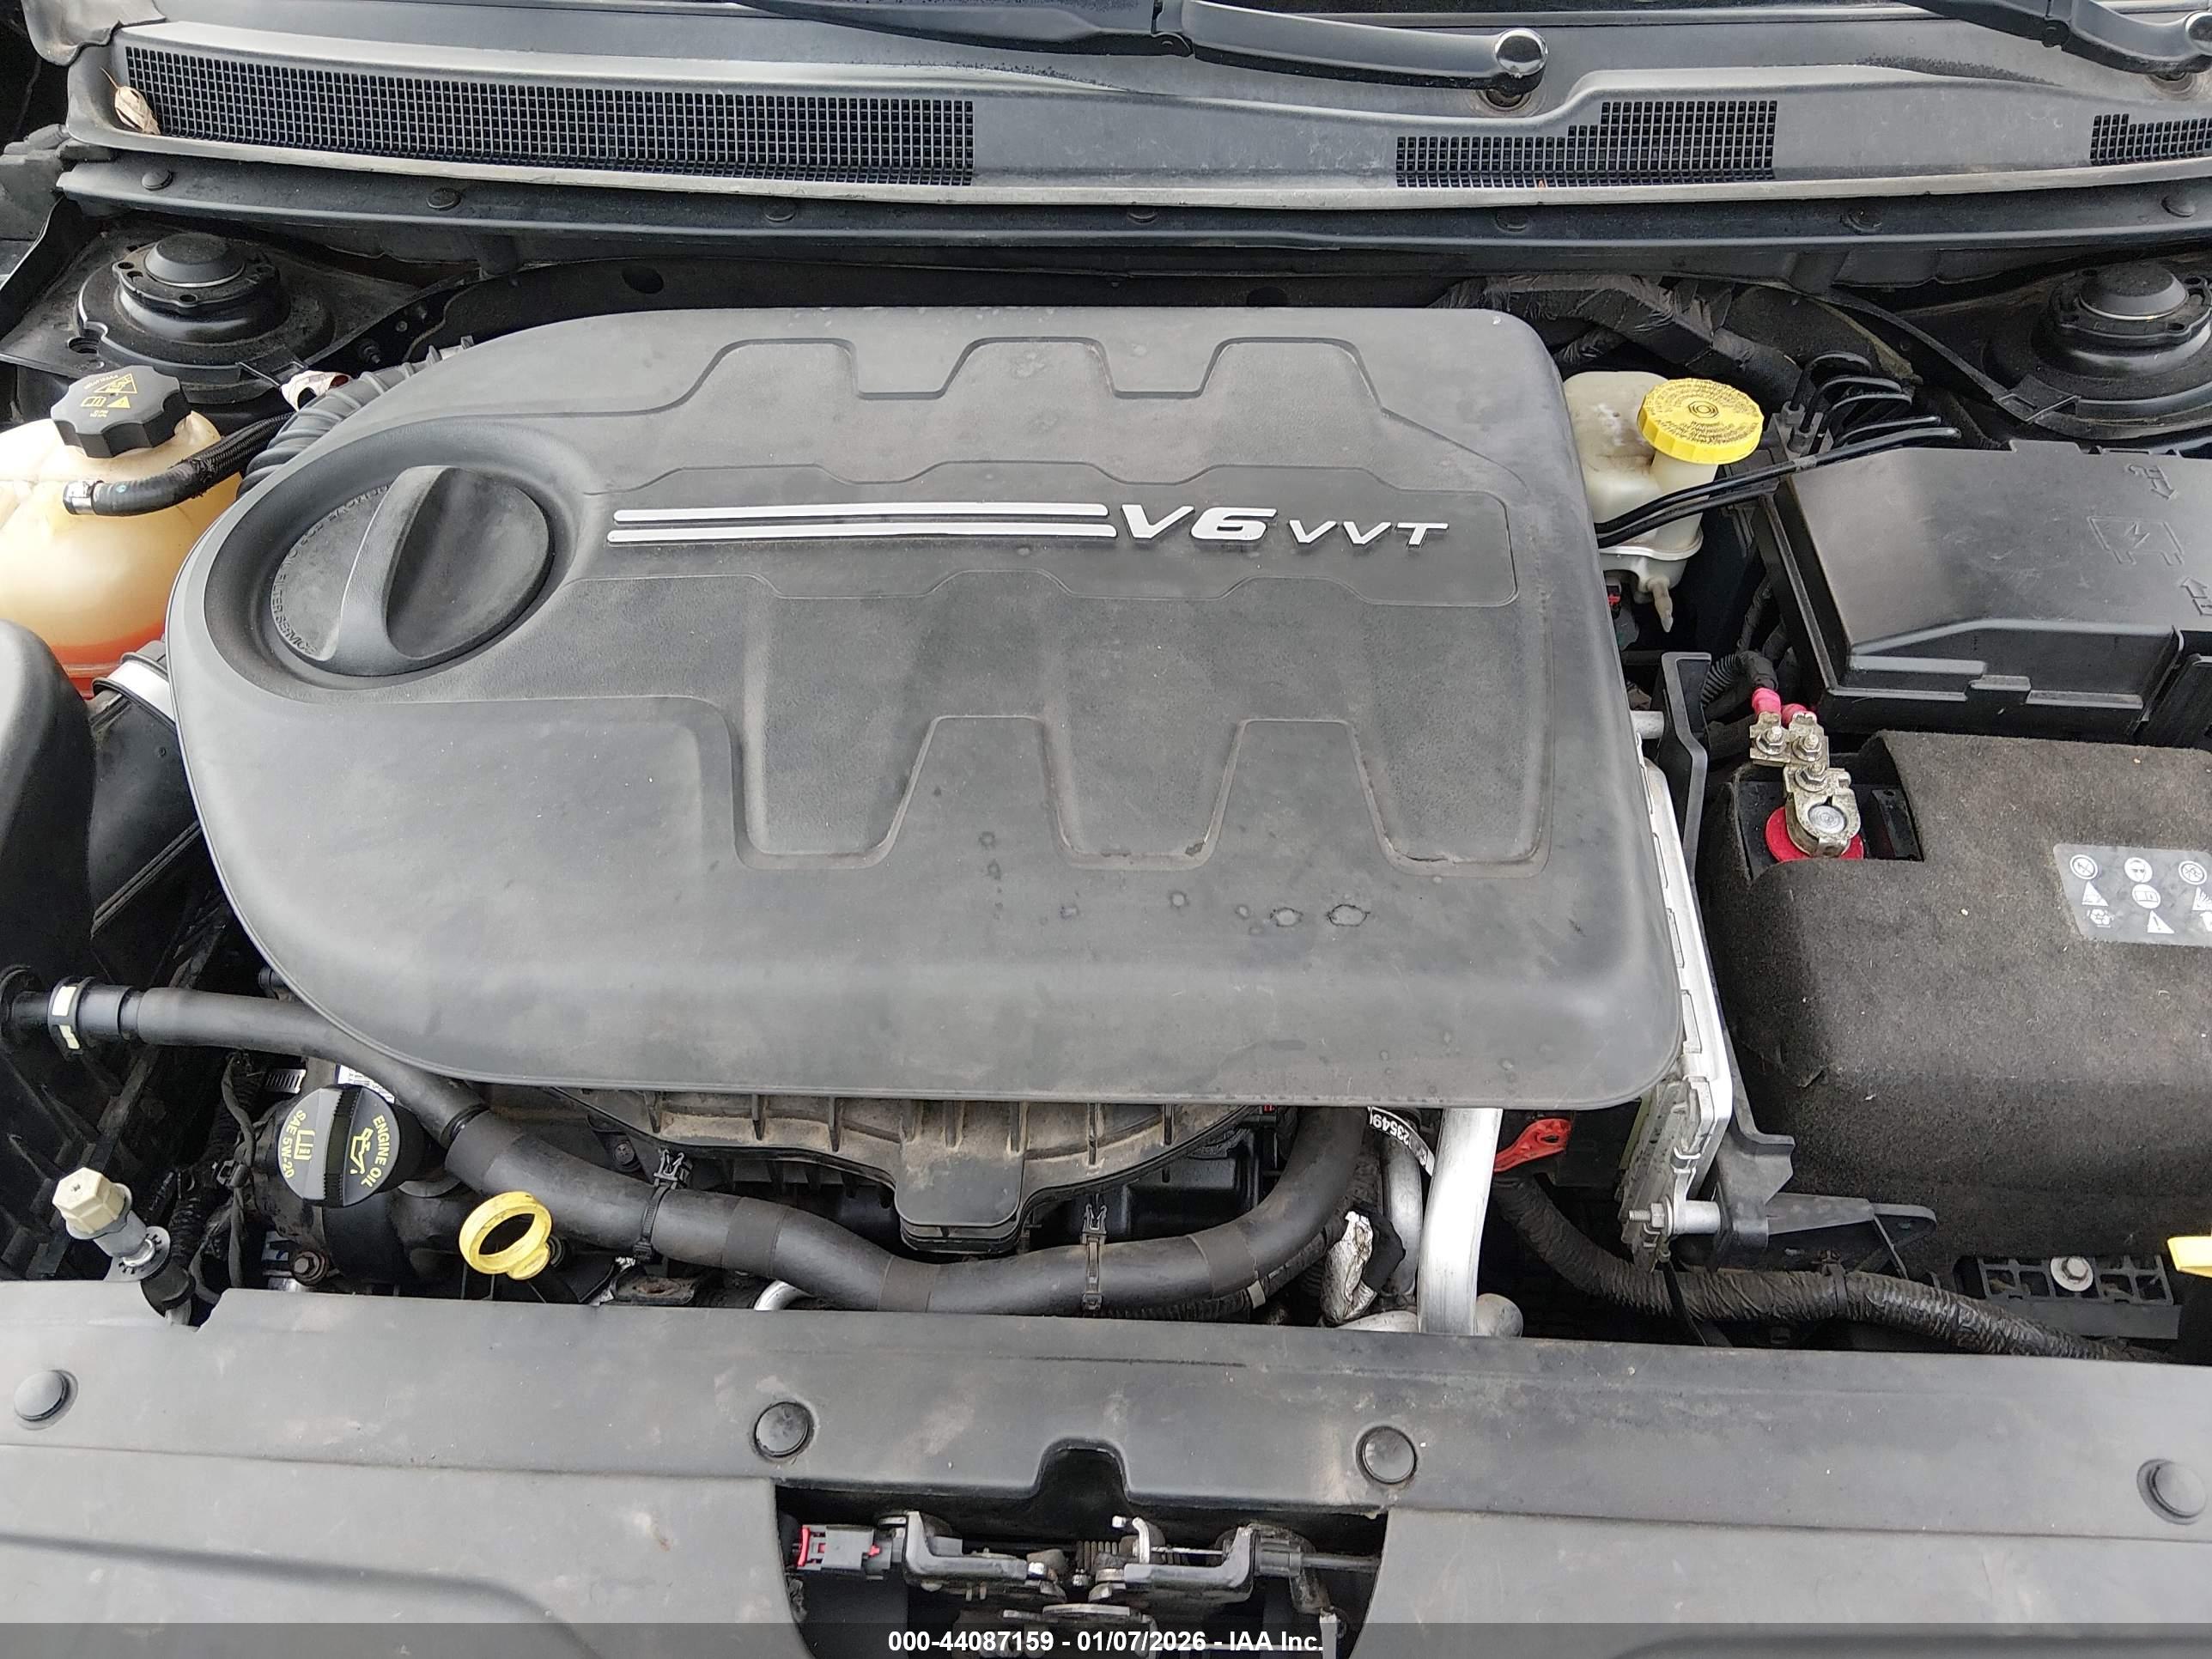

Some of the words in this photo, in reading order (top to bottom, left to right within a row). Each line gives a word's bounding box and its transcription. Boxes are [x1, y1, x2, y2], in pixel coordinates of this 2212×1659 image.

[1121, 504, 1279, 541] V6
[1289, 519, 1449, 546] VVT
[286, 1109, 307, 1135] SAE
[373, 1115, 391, 1166] ENGINE
[281, 1137, 295, 1179] 5W-20
[361, 1167, 382, 1188] OIL
